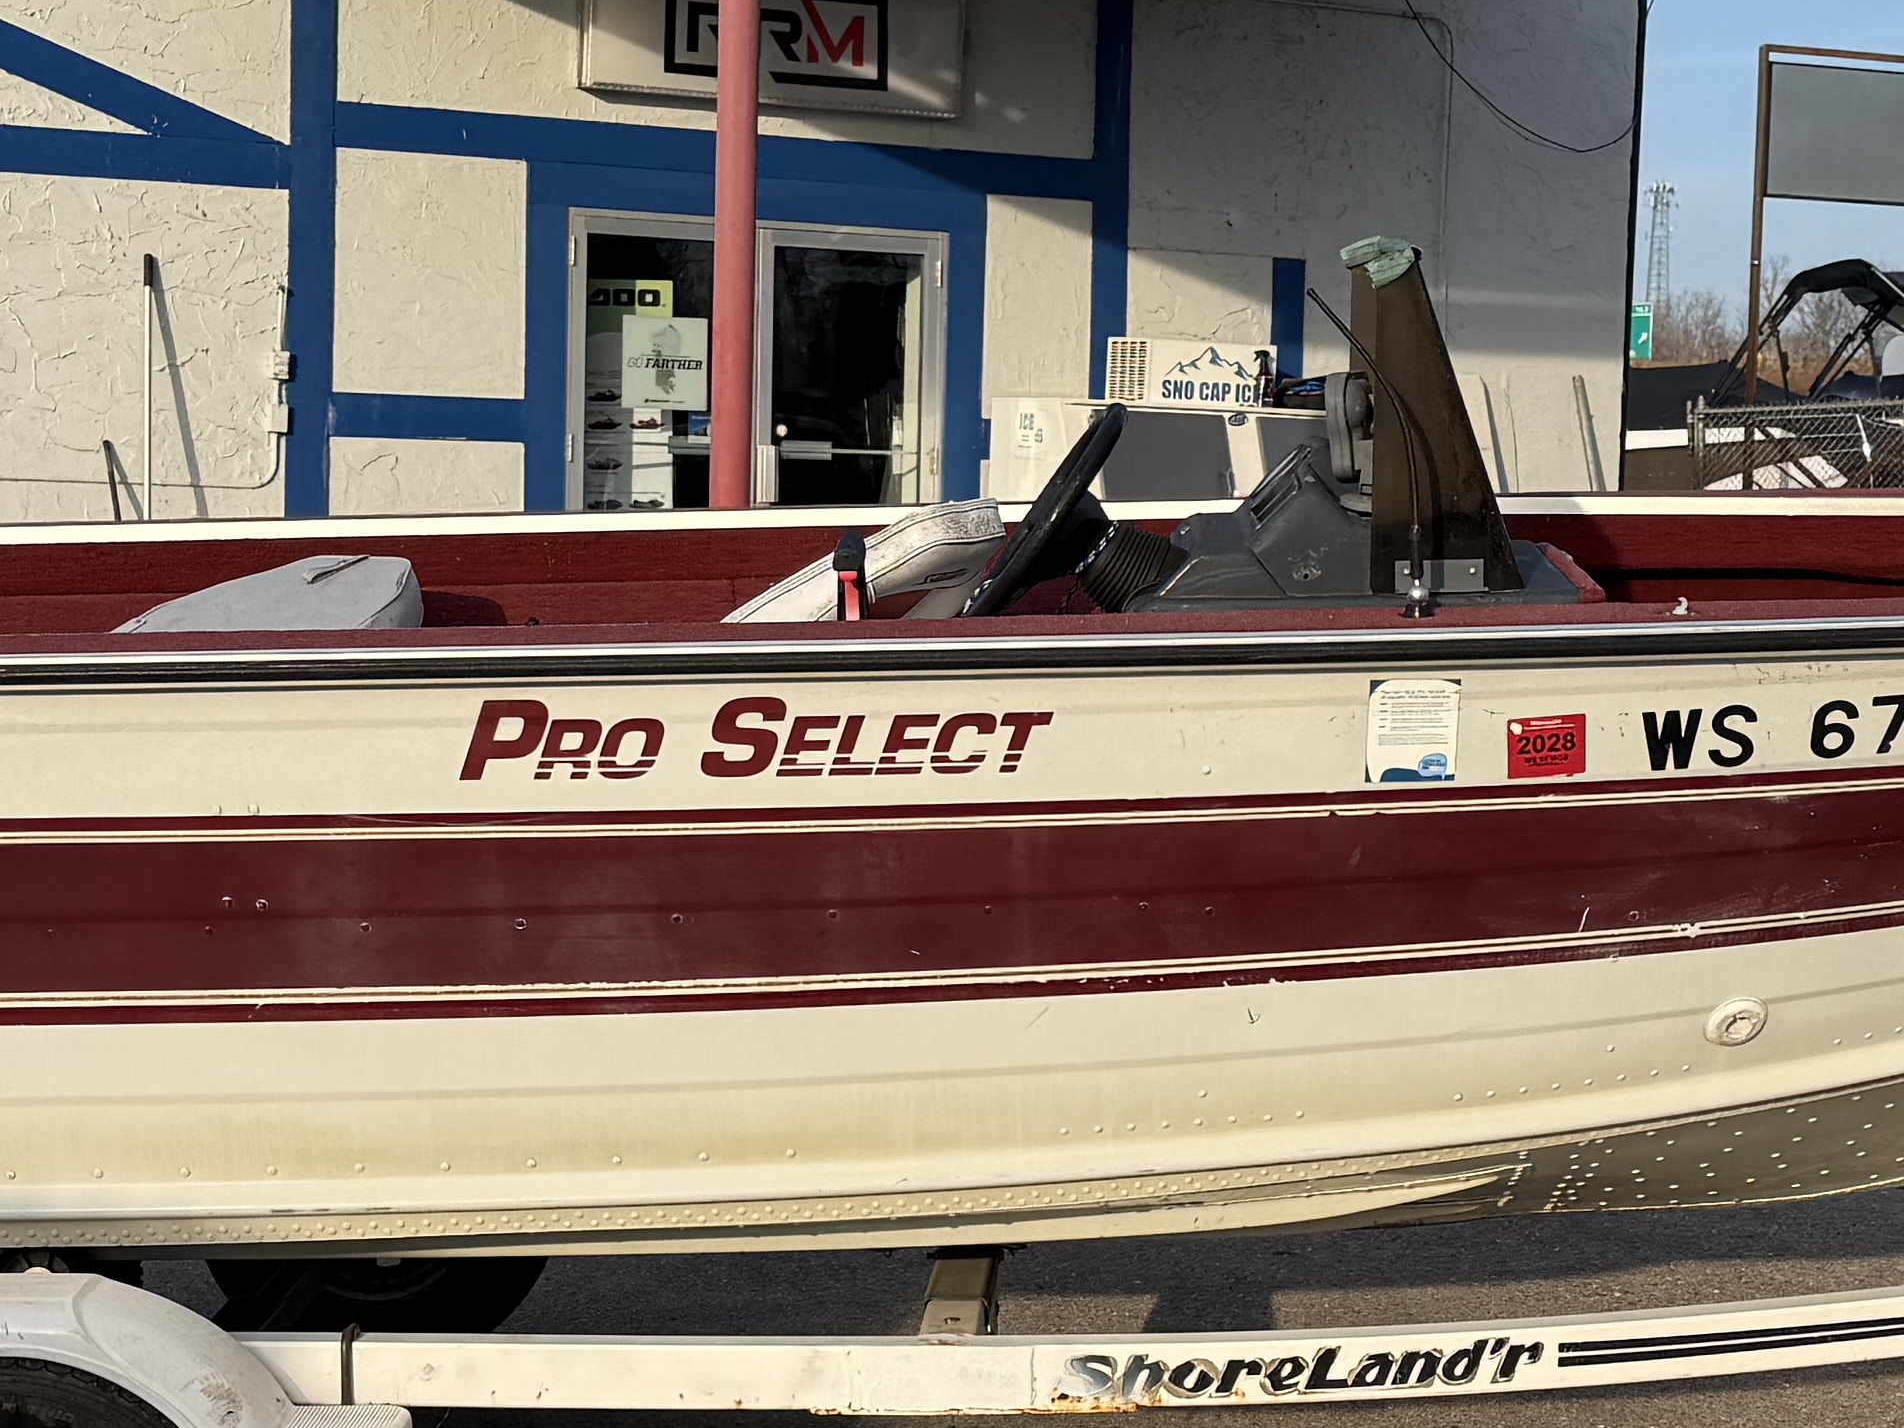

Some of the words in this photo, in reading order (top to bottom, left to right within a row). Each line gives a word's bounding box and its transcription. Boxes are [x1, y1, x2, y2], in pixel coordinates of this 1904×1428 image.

[644, 357, 703, 370] FARTHER
[1161, 379, 1195, 400] SNO
[1199, 381, 1232, 402] CAP
[699, 696, 1054, 778] SELECT
[1516, 731, 1576, 756] 2028
[1641, 704, 1759, 771] WS
